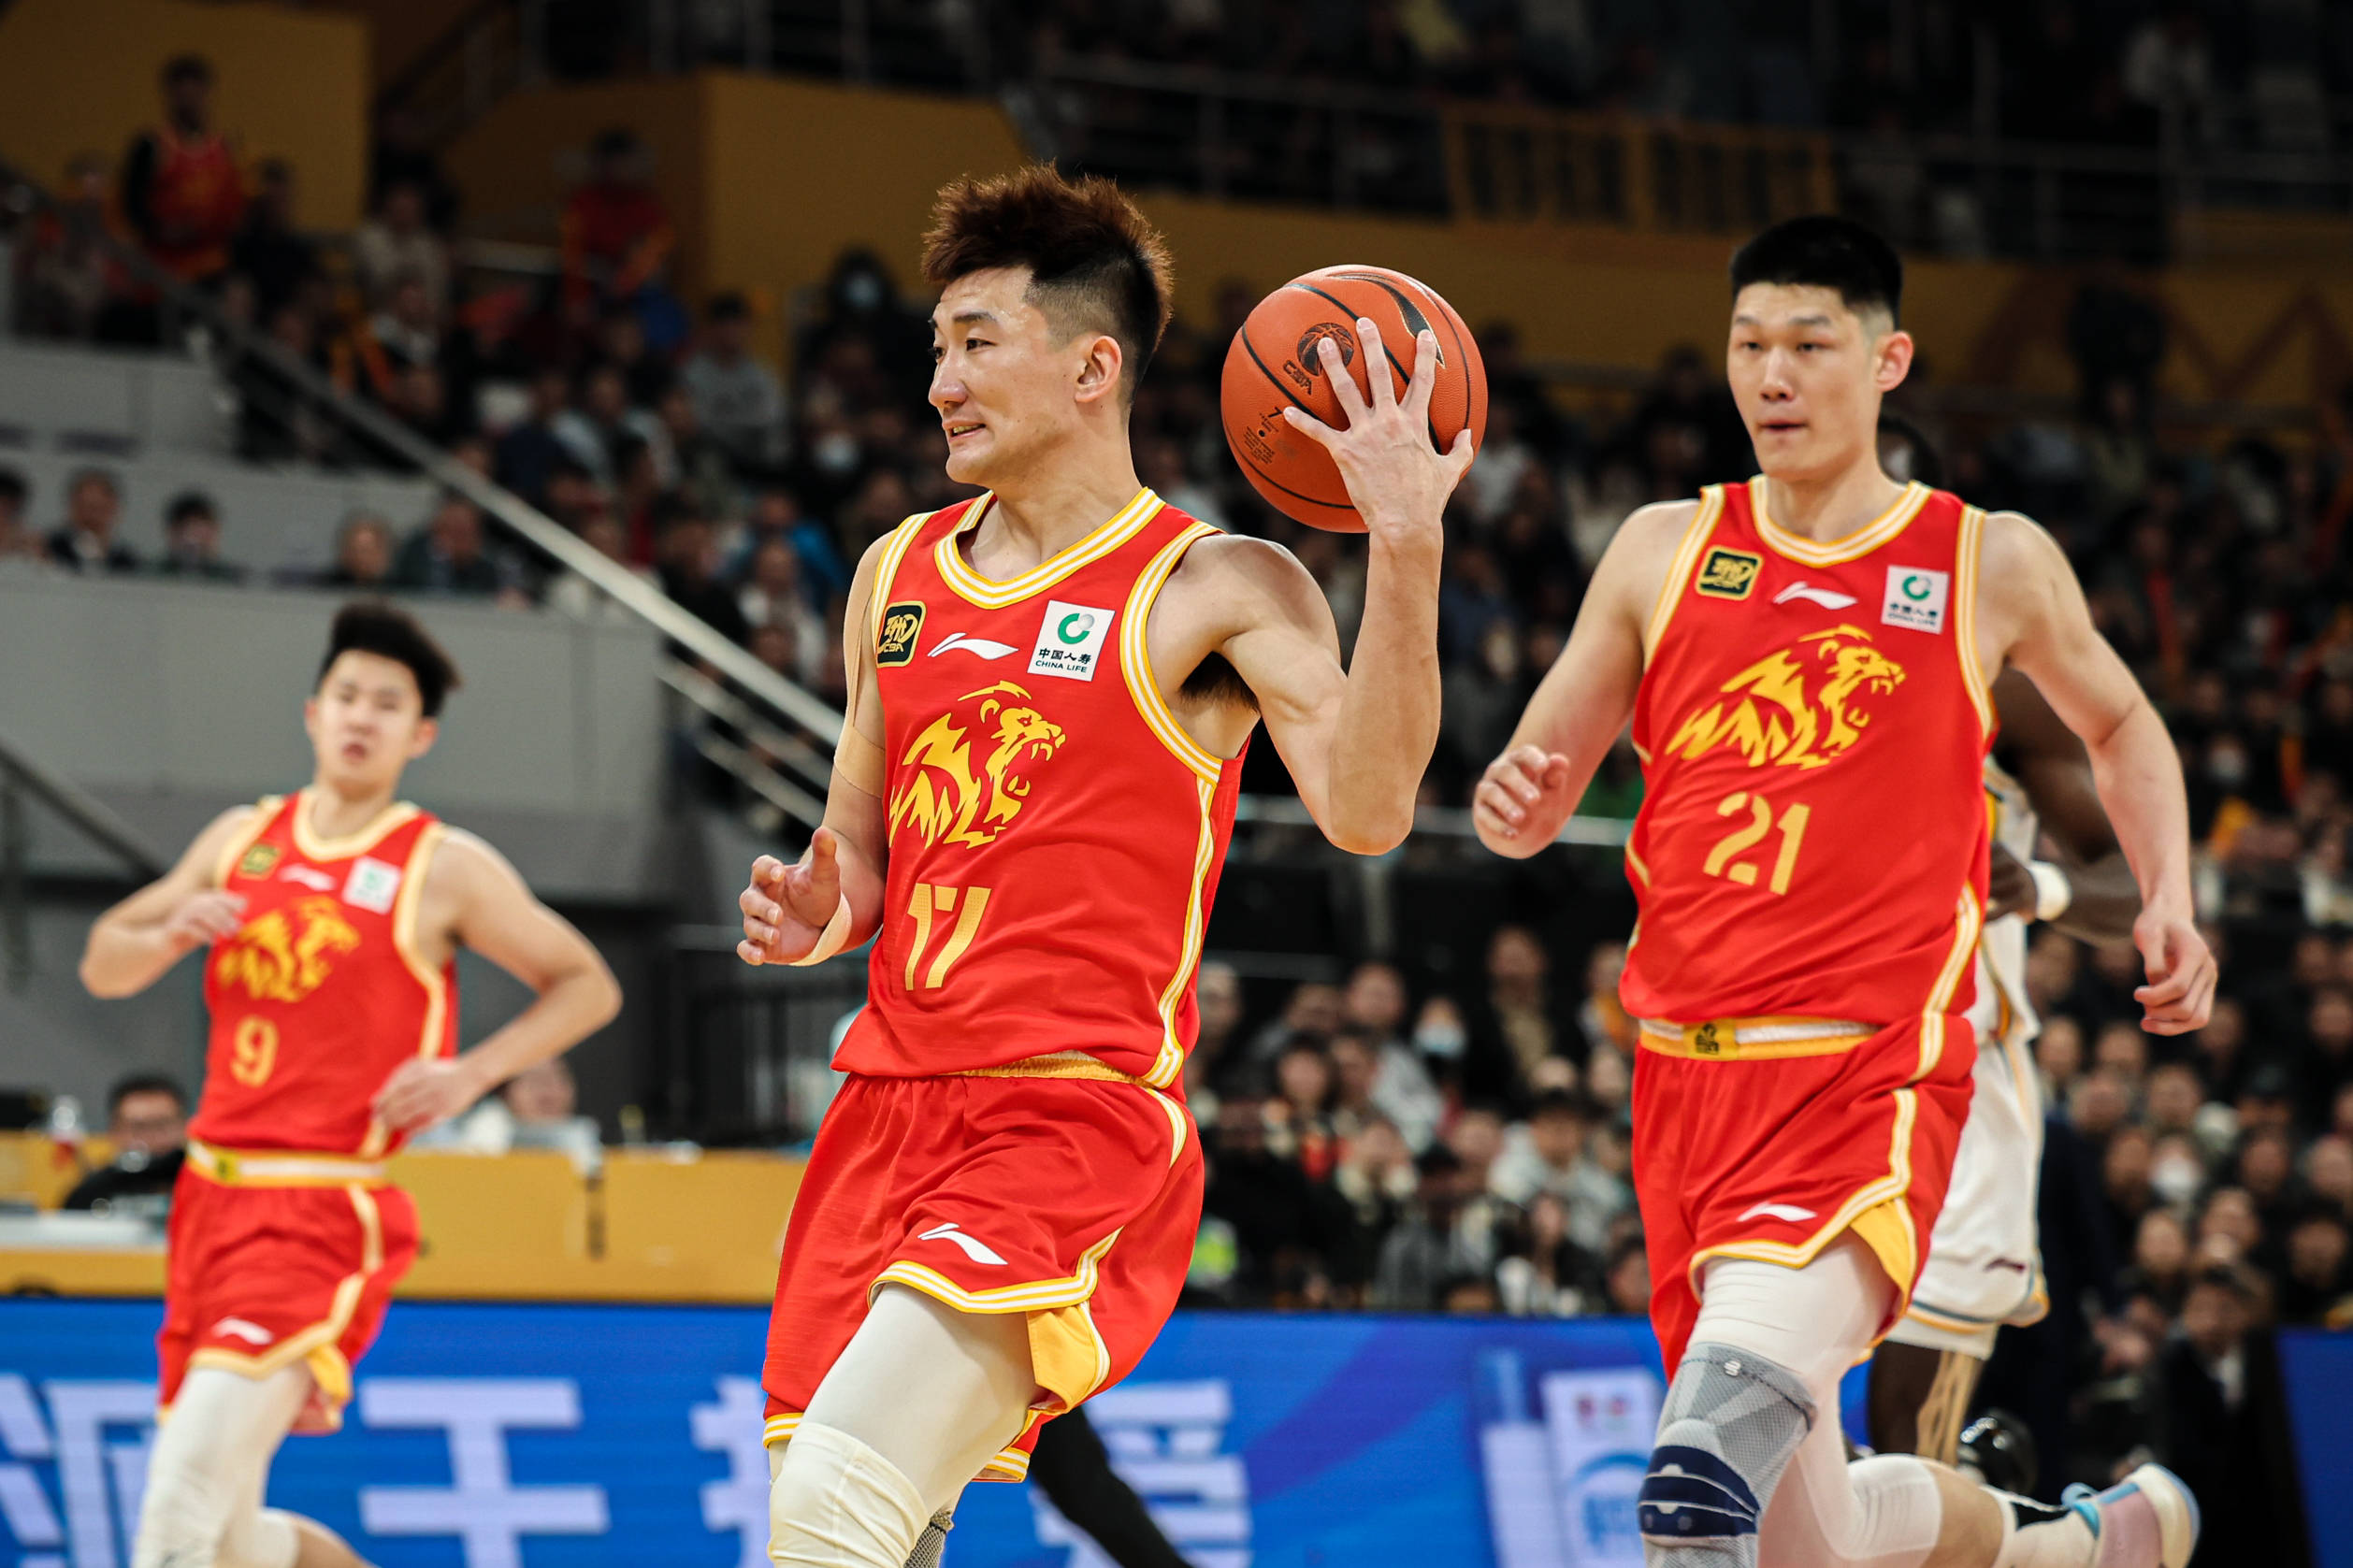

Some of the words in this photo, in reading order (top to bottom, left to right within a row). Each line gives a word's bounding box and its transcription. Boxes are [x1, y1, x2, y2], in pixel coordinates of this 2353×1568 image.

[1035, 660, 1063, 669] CHINA
[1067, 665, 1088, 673] LIFE
[1038, 648, 1091, 665] 中国人寿
[1703, 791, 1812, 896] 21
[905, 883, 991, 991] 17
[230, 1014, 280, 1088] 9
